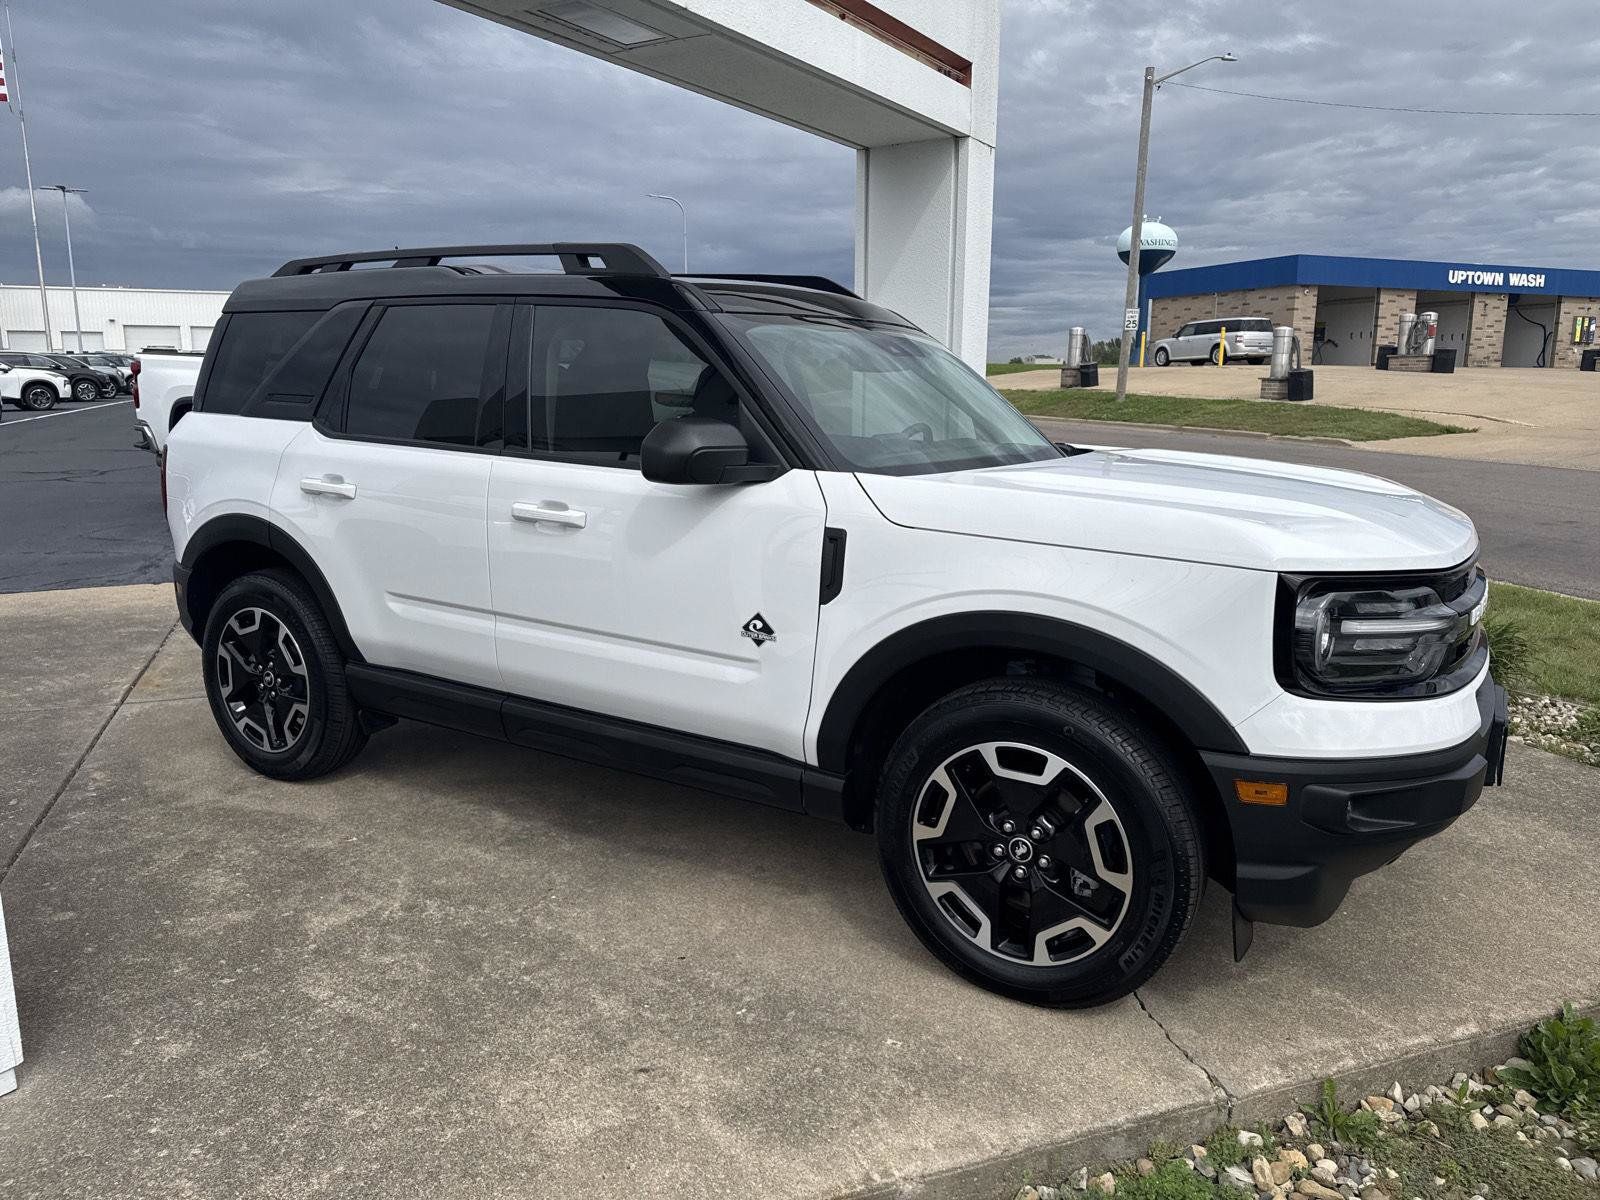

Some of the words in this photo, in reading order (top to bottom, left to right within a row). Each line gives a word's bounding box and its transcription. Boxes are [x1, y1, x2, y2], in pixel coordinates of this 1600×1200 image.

[1448, 270, 1503, 286] UPTOWN
[1509, 272, 1546, 288] WASH
[1125, 319, 1137, 329] 25
[1122, 891, 1165, 971] MICHELIN
